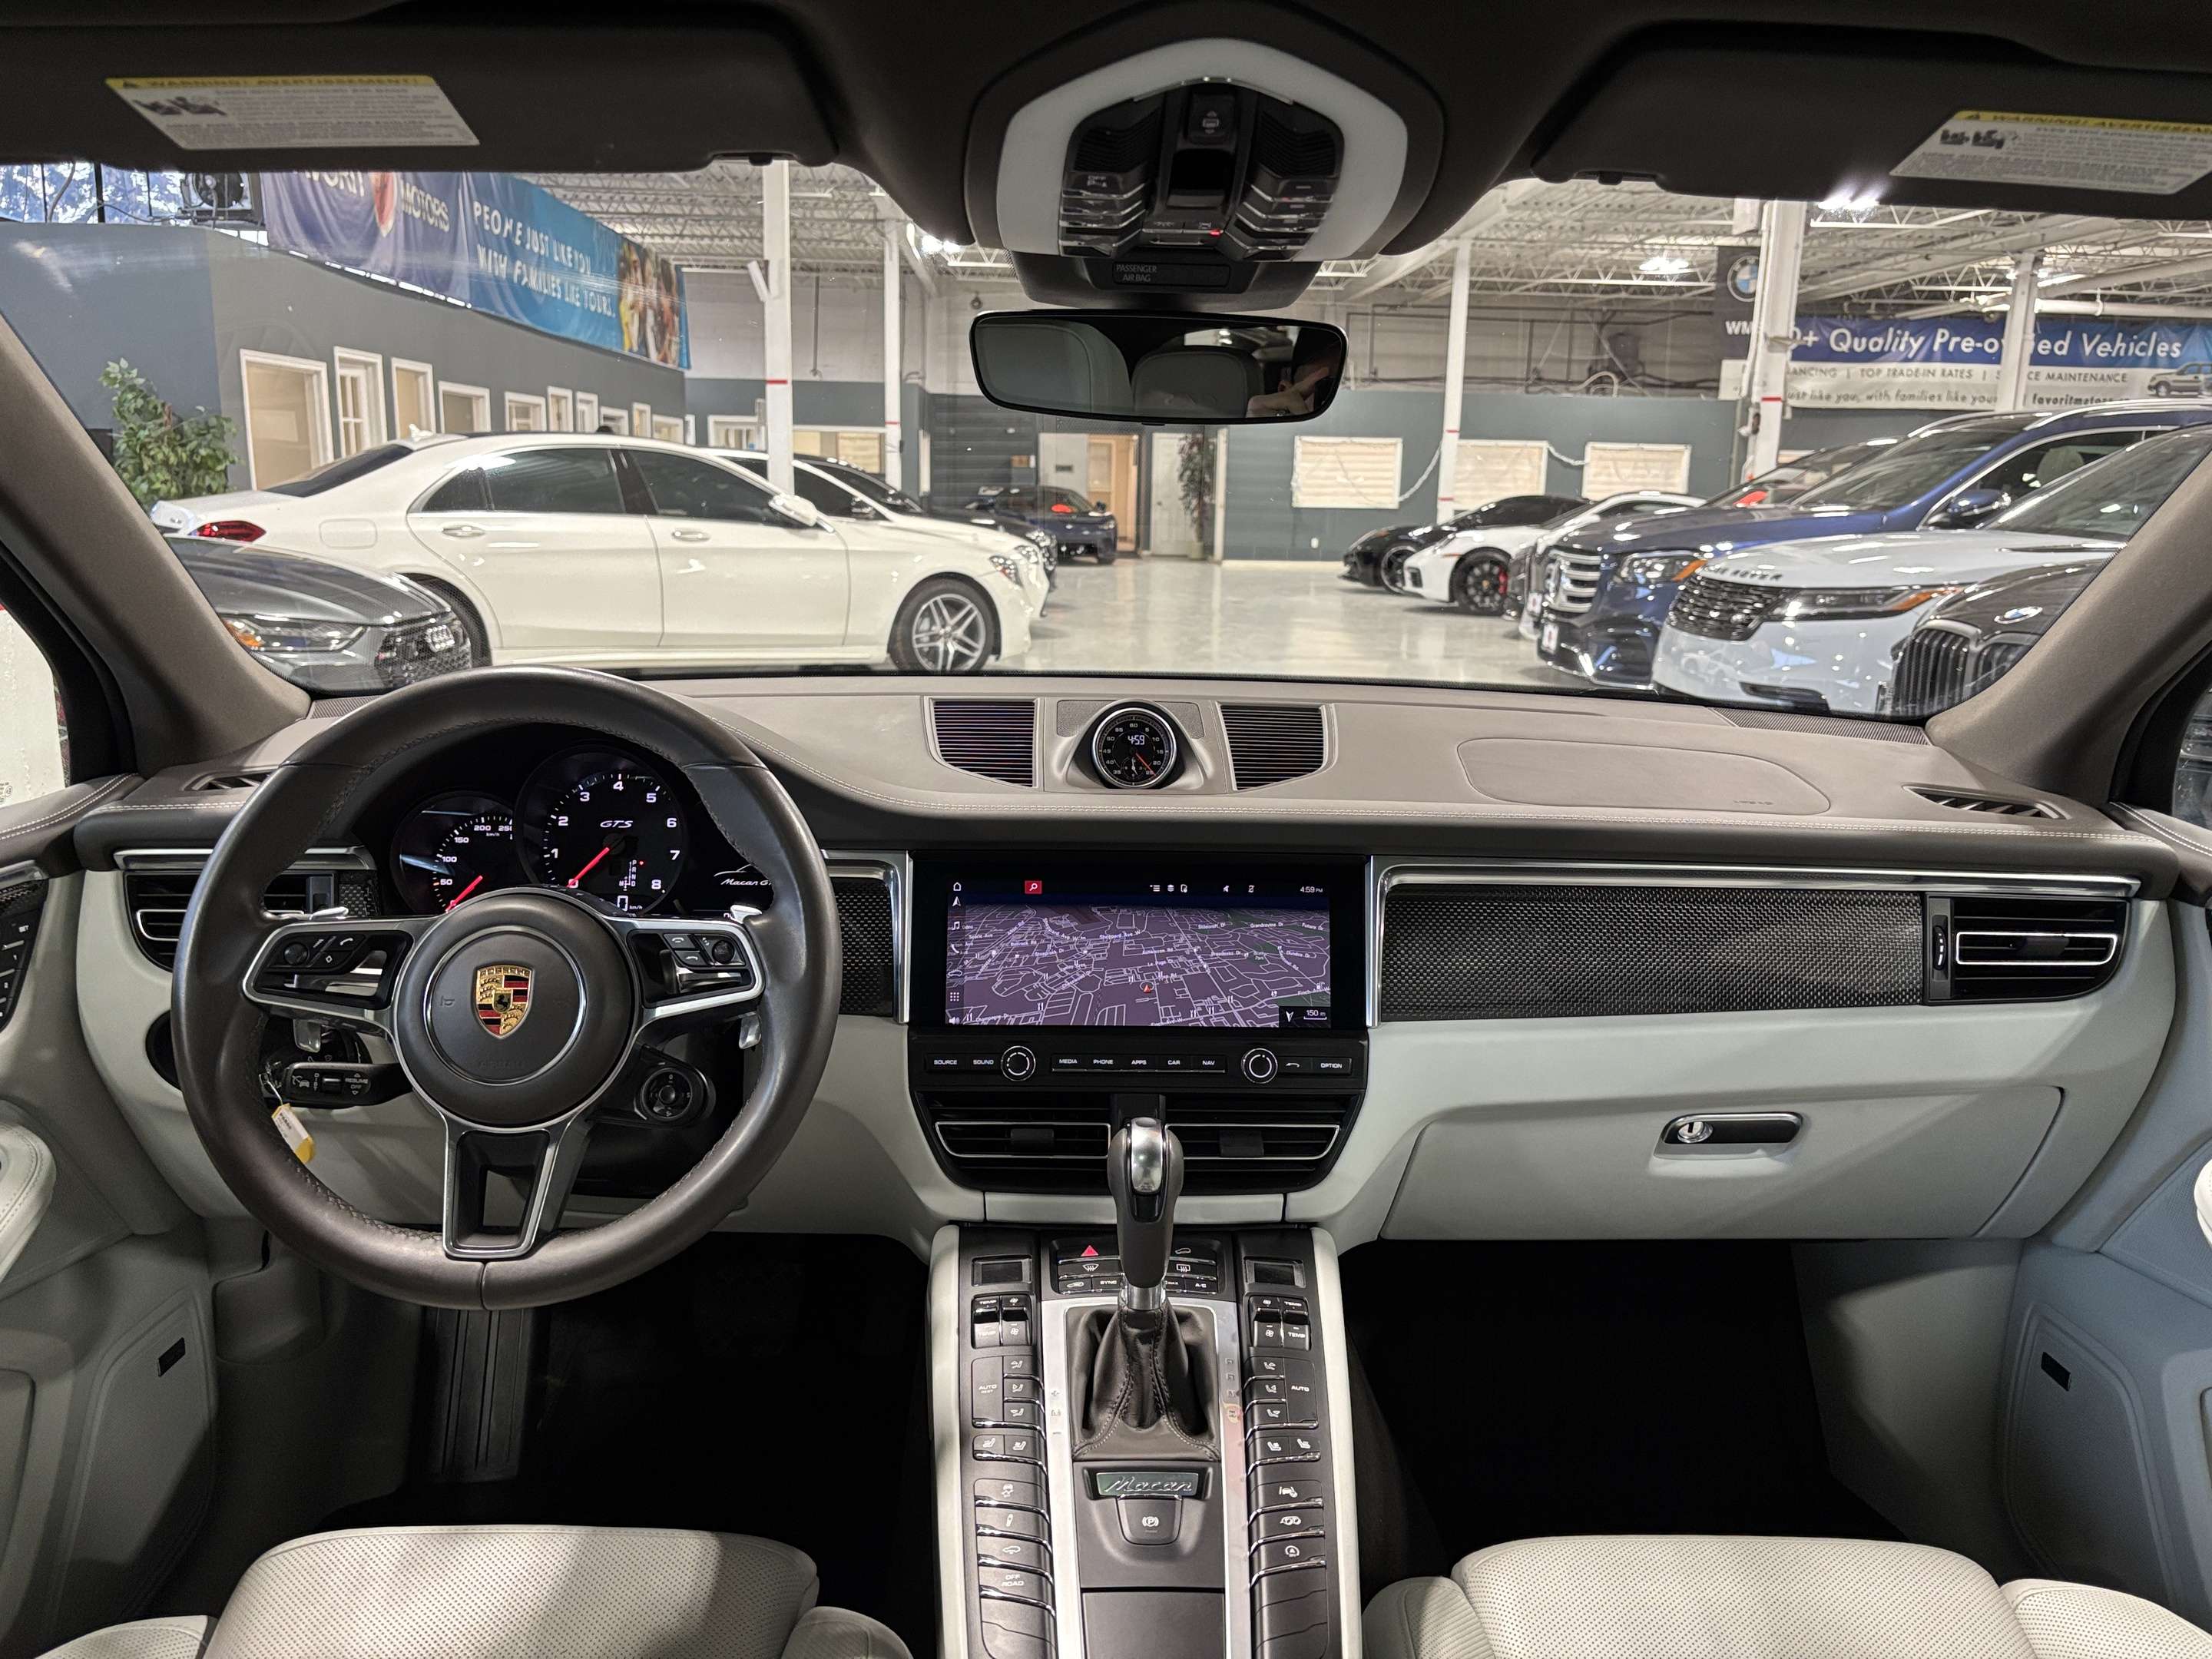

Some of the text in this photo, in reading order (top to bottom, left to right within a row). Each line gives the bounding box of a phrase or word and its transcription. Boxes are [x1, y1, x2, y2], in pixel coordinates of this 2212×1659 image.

[400, 177, 450, 233] MOTORS
[525, 227, 549, 258] JUST
[476, 243, 508, 280] WITH
[1116, 263, 1157, 273] PASSENGER
[1829, 326, 1926, 359] Quality
[1932, 328, 2072, 358] Pre-oed
[2082, 331, 2183, 359] Vehicles
[1860, 368, 1883, 378] TOP
[2045, 373, 2128, 383] MAINTENANCE
[1866, 390, 1890, 401] with
[613, 781, 624, 791] 4
[579, 792, 590, 802] 3
[645, 793, 657, 803] 5
[558, 816, 569, 826] 2
[666, 817, 677, 828] 6
[550, 848, 559, 859] 1
[670, 849, 680, 860] 7
[651, 879, 662, 890] 8
[1104, 1475, 1194, 1492] Macan
